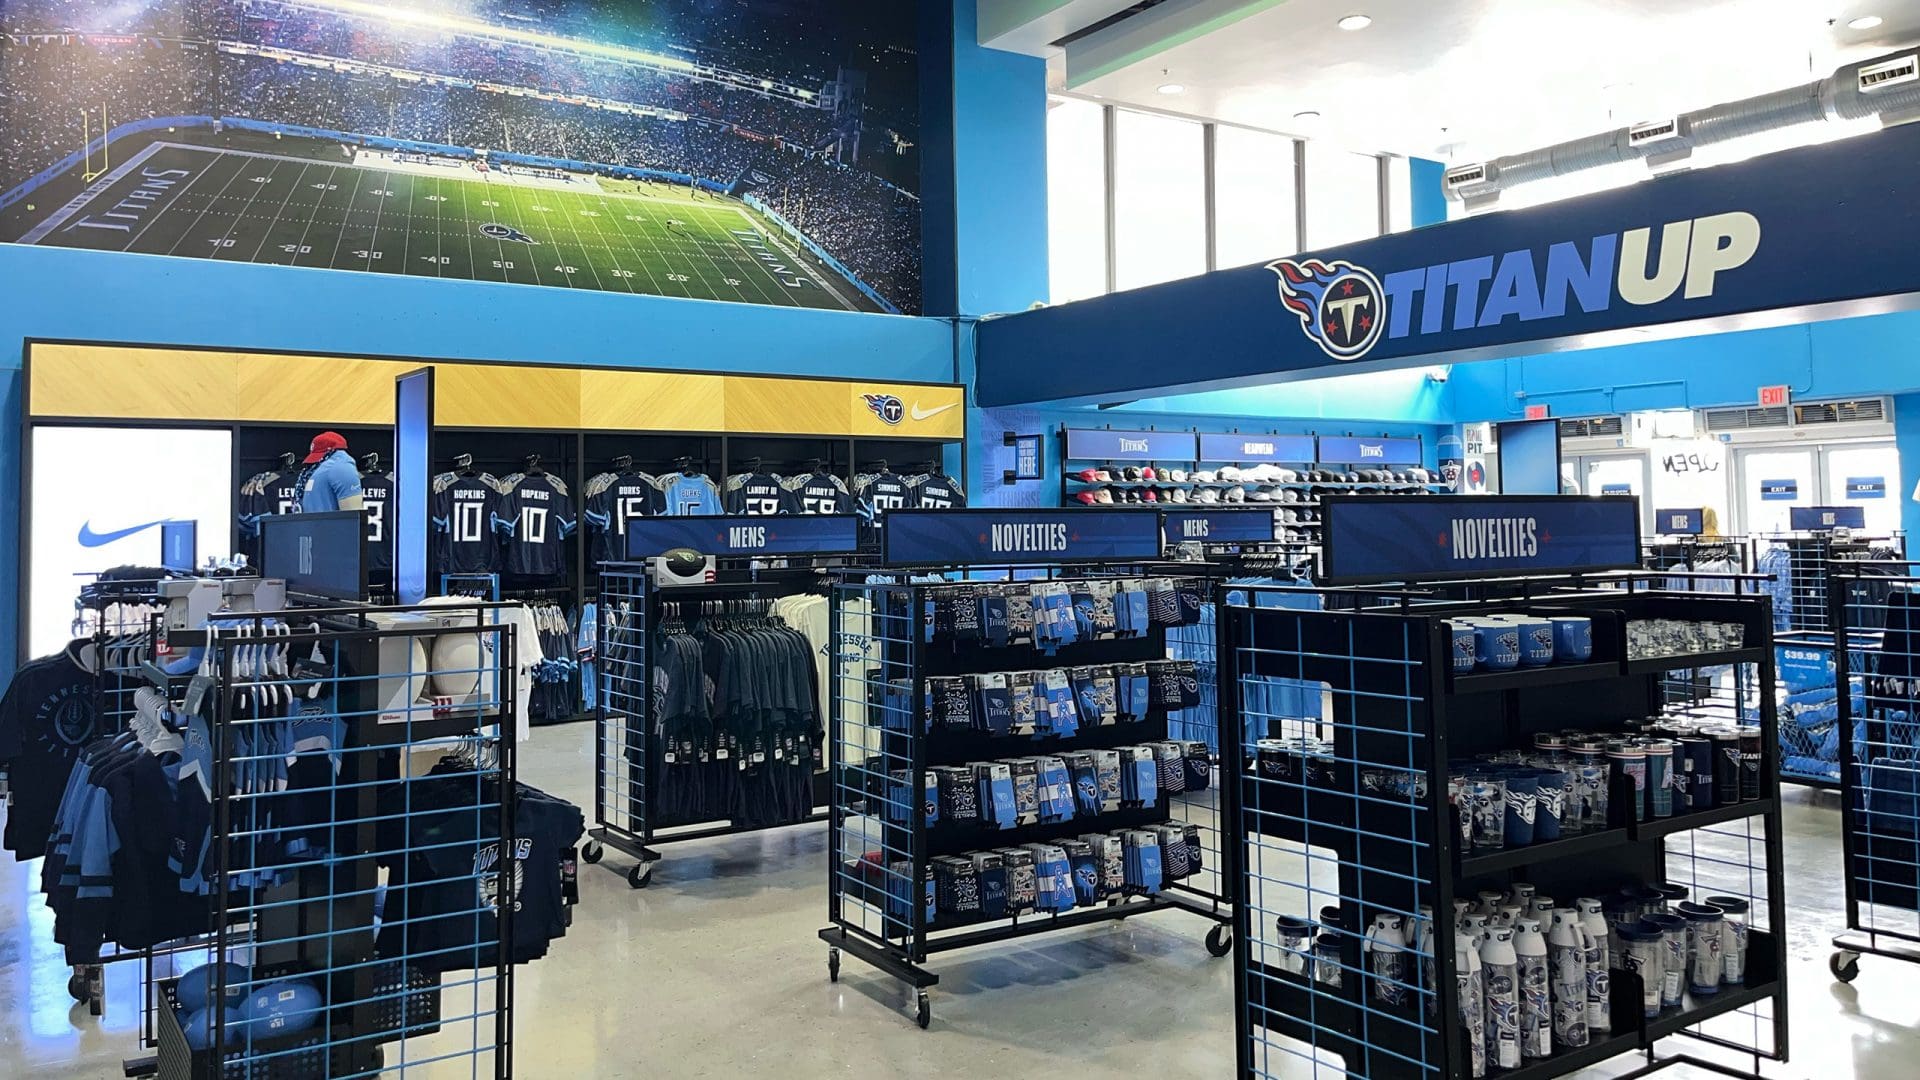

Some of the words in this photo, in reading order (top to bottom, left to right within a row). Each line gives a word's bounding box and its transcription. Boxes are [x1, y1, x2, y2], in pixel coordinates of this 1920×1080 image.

[62, 167, 190, 233] TITANS
[1762, 387, 1785, 404] EXIT
[1467, 442, 1483, 455] PIT
[362, 488, 386, 498] LEVIS
[454, 490, 486, 499] HOPKINS
[521, 489, 550, 500] HOPKINS
[618, 486, 641, 495] BURKS
[747, 486, 770, 495] LANDRY
[805, 487, 828, 496] LANDRY
[877, 484, 901, 493] SIMMONS
[925, 486, 949, 497] SIMMONS
[454, 502, 484, 542] 10
[522, 506, 548, 543] 10
[1183, 519, 1209, 537] MENS
[1671, 514, 1689, 530] MENS
[729, 526, 766, 549] MENS
[991, 523, 1067, 552] NOVELTIES
[1451, 517, 1538, 560] NOVELTIES
[1784, 650, 1820, 661] $39.99
